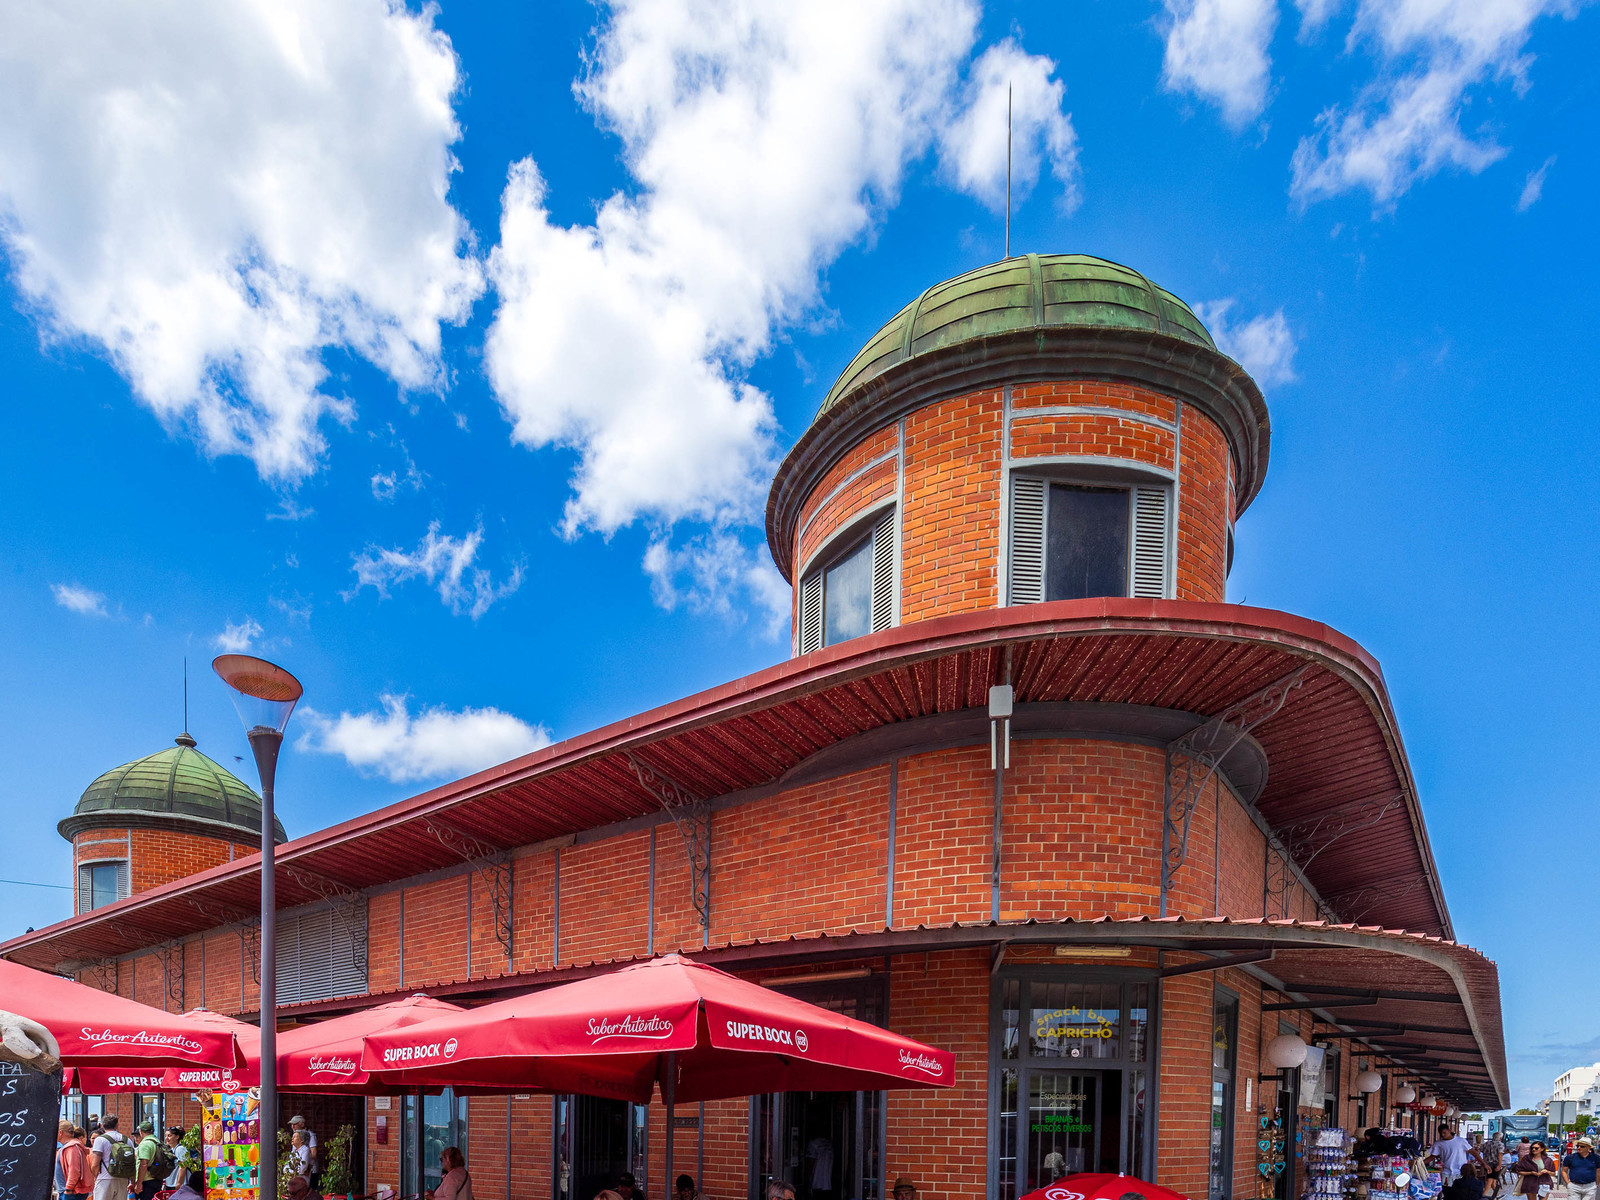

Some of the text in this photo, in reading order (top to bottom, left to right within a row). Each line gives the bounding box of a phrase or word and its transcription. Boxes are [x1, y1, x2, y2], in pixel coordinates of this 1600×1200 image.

[1036, 1006, 1112, 1028] snack bar
[586, 1015, 617, 1035] Sabor
[79, 1027, 130, 1042] Sabor
[727, 1021, 793, 1046] SUPER BOCK
[1036, 1027, 1112, 1038] CAPRICHO
[384, 1043, 441, 1062] SUPER BOCK
[898, 1049, 918, 1065] Sabor
[308, 1056, 328, 1070] Sabor
[108, 1076, 148, 1087] SUPER
[178, 1072, 200, 1082] SUPER
[201, 1070, 220, 1082] BOCK
[1044, 1115, 1074, 1124] BIFANAS
[1032, 1124, 1092, 1132] PETISCOS DIVERSOS
